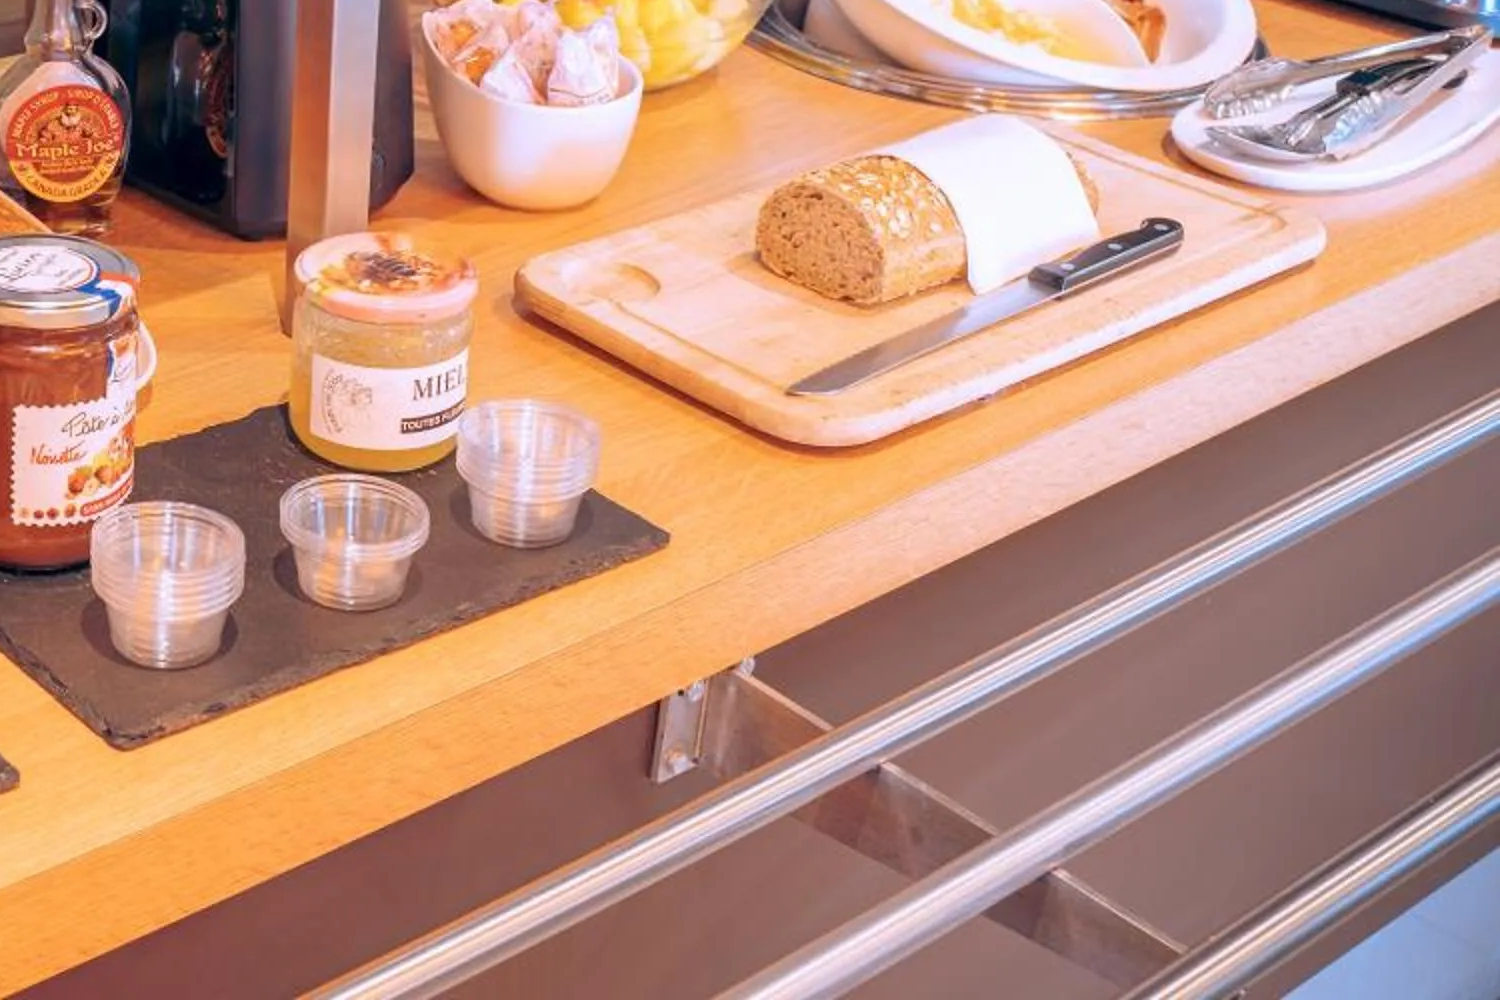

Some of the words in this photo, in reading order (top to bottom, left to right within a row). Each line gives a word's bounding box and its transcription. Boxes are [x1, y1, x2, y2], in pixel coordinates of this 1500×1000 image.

[15, 142, 79, 160] Maple
[85, 137, 114, 155] Joe
[413, 363, 465, 401] MIEL
[401, 414, 441, 432] TOUTES
